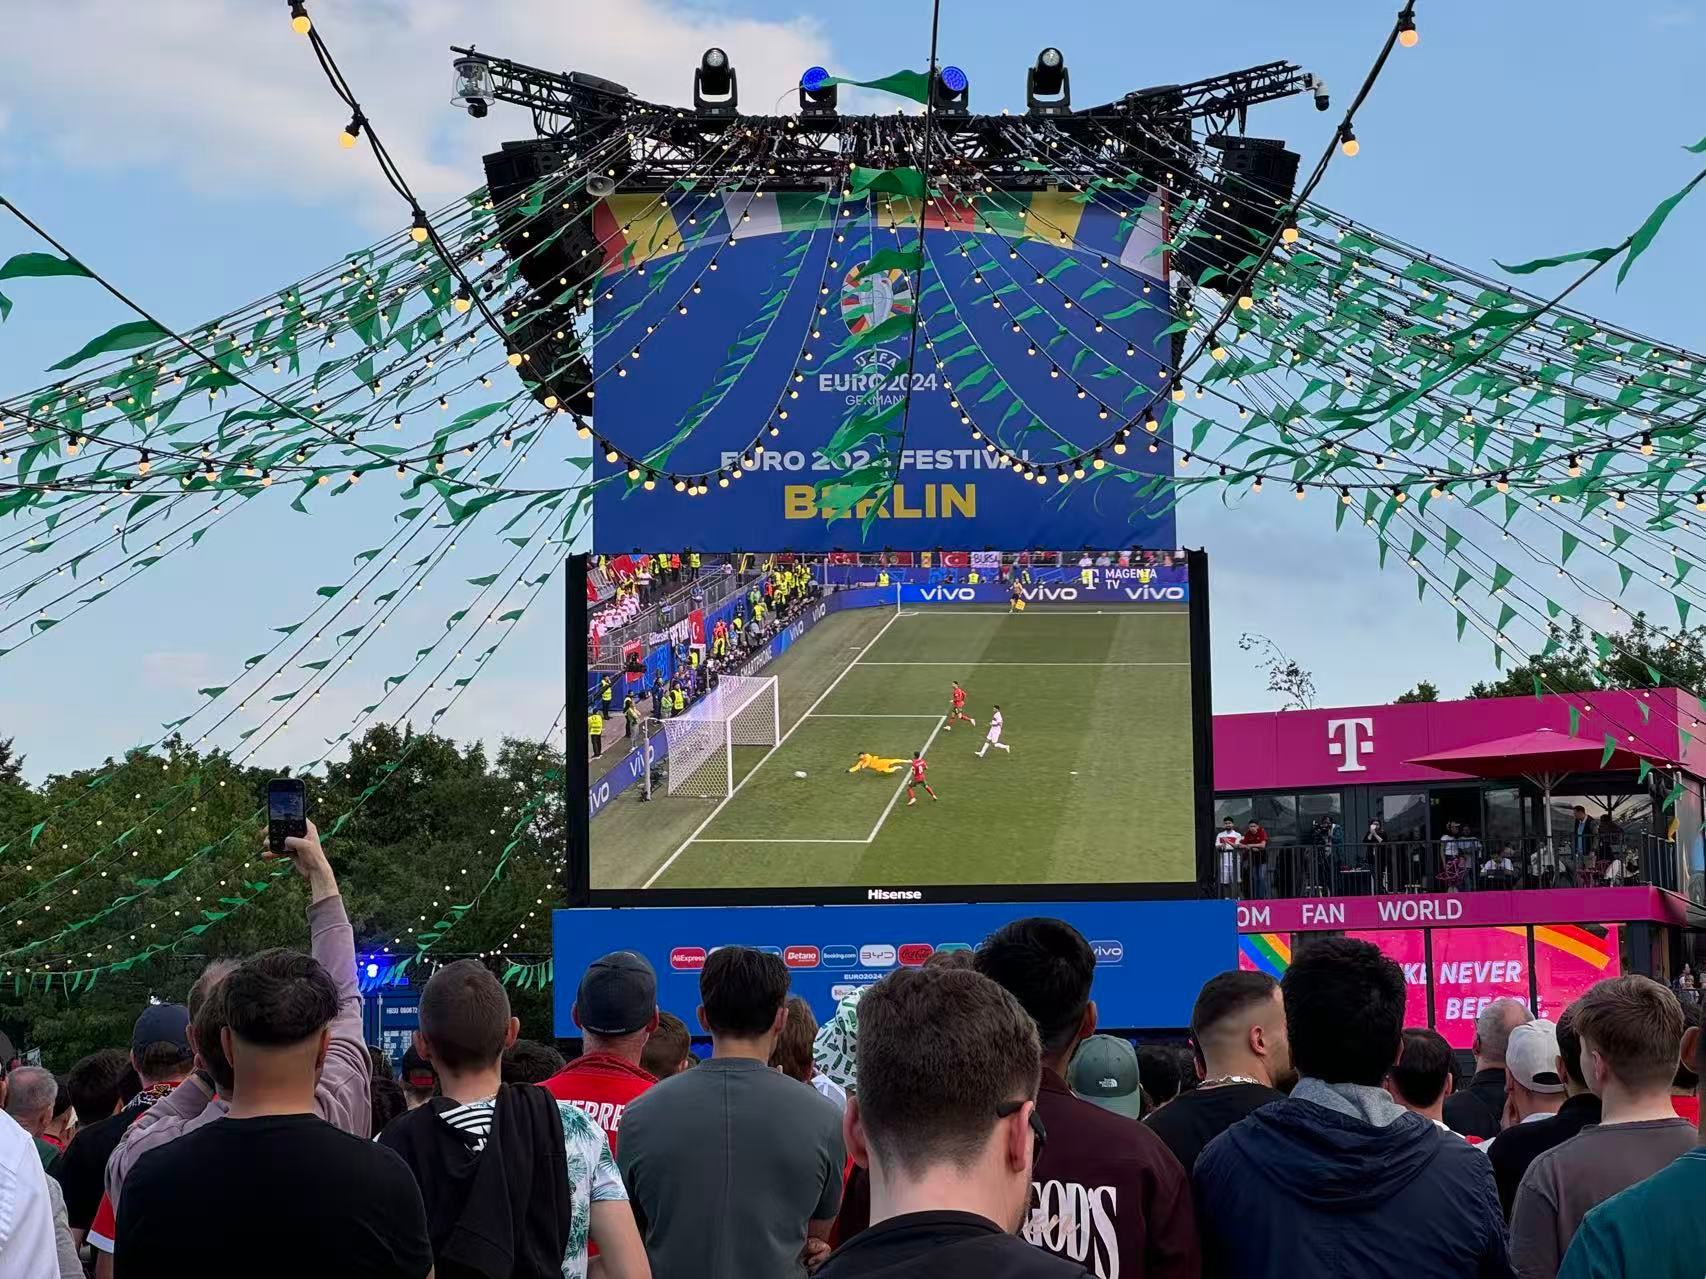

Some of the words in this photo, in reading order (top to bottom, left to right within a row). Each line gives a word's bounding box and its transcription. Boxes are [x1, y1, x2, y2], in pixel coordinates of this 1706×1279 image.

[721, 451, 805, 471] EURO
[812, 450, 892, 470] 202
[920, 584, 975, 600] vivo
[1023, 584, 1077, 600] vivo
[1105, 579, 1119, 589] TV
[1124, 584, 1184, 600] vivo
[867, 889, 922, 899] Hisense
[1302, 903, 1345, 924] FAN
[1378, 899, 1463, 921] WORLD
[788, 952, 816, 960] Betano
[1440, 961, 1522, 984] NEVER
